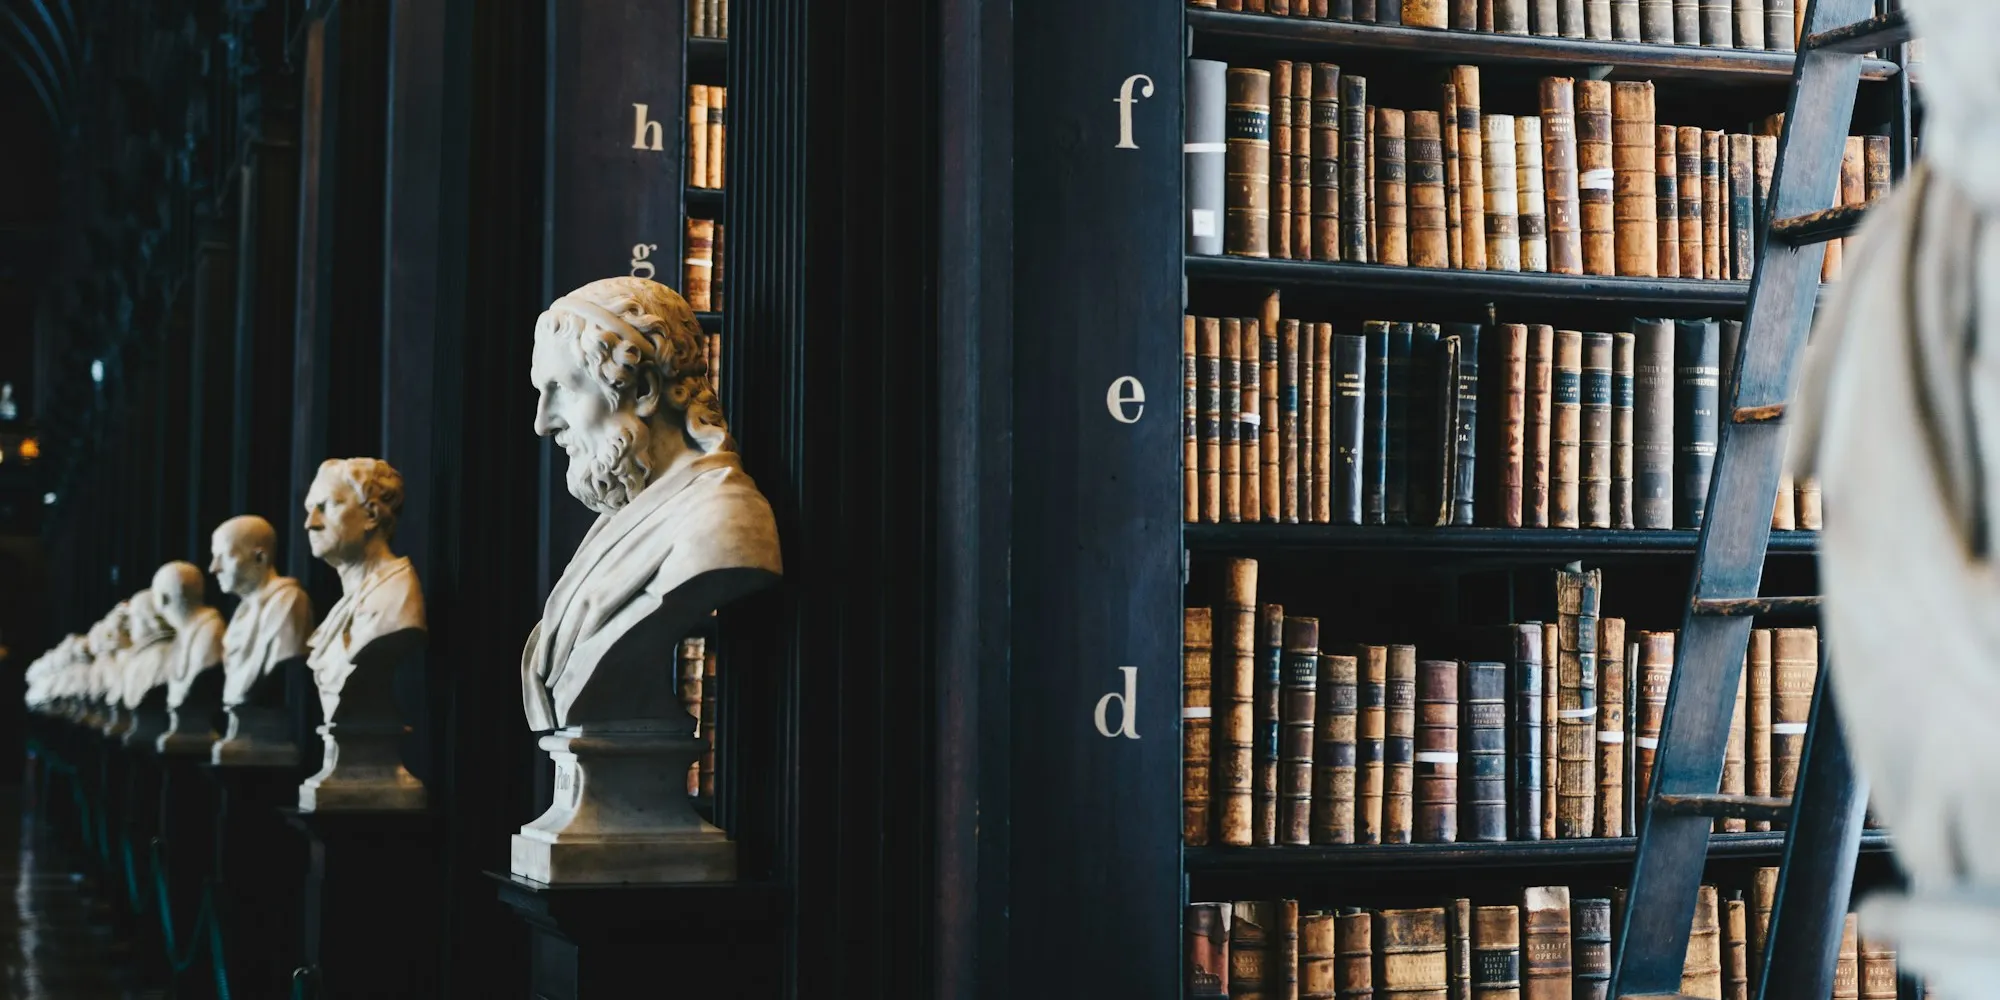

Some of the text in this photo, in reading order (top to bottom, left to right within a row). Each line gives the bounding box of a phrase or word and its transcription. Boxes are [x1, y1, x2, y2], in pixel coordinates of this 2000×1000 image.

[632, 103, 664, 150] h
[1113, 74, 1154, 149] f
[630, 243, 658, 280] g
[1107, 375, 1145, 423] e
[1094, 666, 1141, 739] d
[1643, 685, 1668, 693] BIBL
[1534, 952, 1562, 960] OPERA
[1869, 967, 1890, 975] HOLY
